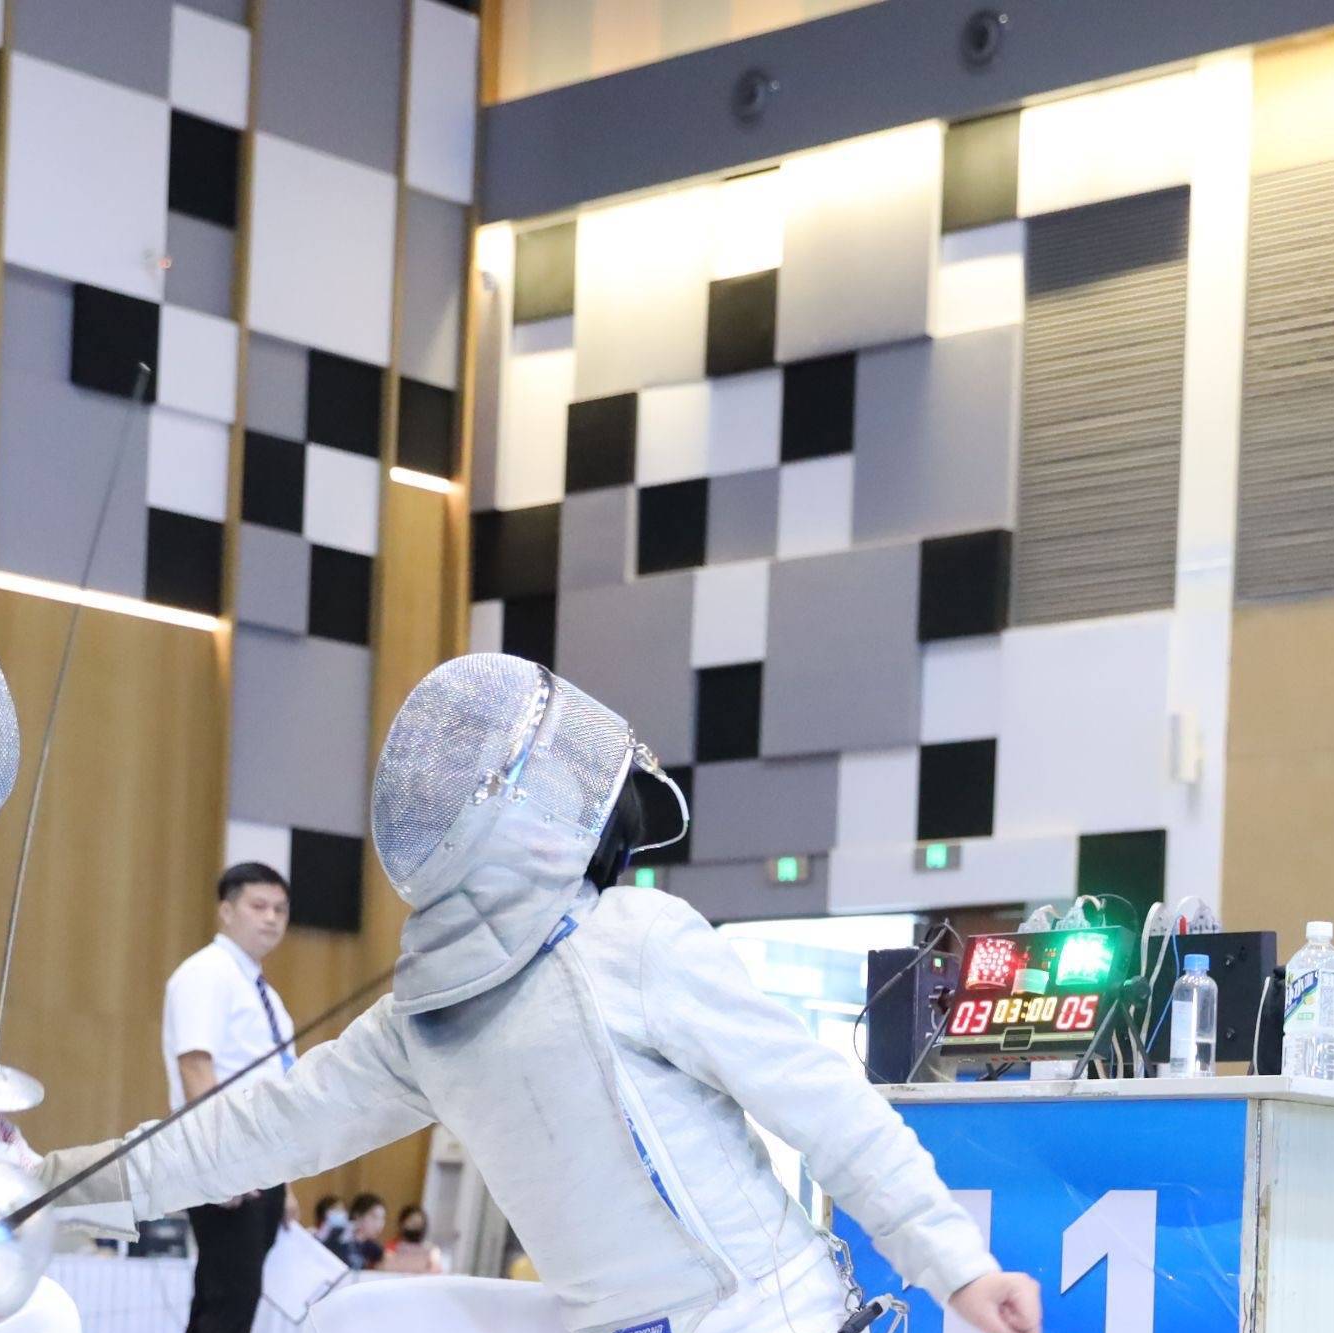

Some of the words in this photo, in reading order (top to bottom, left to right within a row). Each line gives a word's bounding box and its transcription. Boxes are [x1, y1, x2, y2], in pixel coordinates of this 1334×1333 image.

[951, 1000, 994, 1034] 03
[992, 996, 1058, 1024] 03:00
[1055, 994, 1099, 1031] 05
